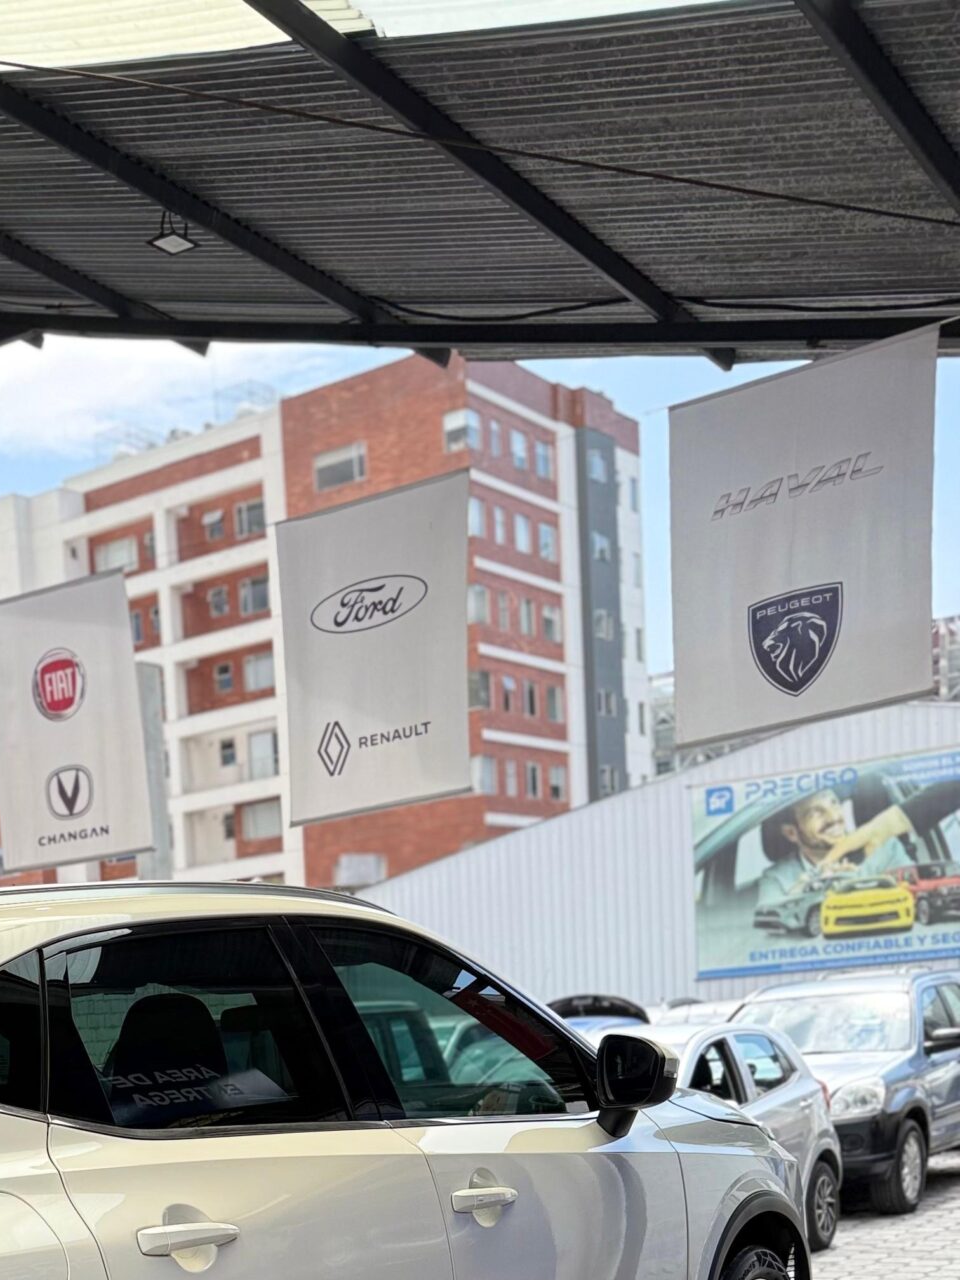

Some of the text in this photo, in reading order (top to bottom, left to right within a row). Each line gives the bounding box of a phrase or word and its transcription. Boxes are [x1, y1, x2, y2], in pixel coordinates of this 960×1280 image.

[711, 452, 883, 521] HAVAL
[333, 582, 403, 628] Ford
[756, 592, 833, 620] PEUGEOT
[44, 667, 74, 703] FIAT
[358, 721, 431, 749] RENAULT
[745, 767, 858, 801] PRECISO
[38, 825, 110, 847] CHANGAN
[750, 946, 821, 961] ENTREGA
[823, 936, 912, 955] CONFIABLE
[916, 934, 927, 946] Y
